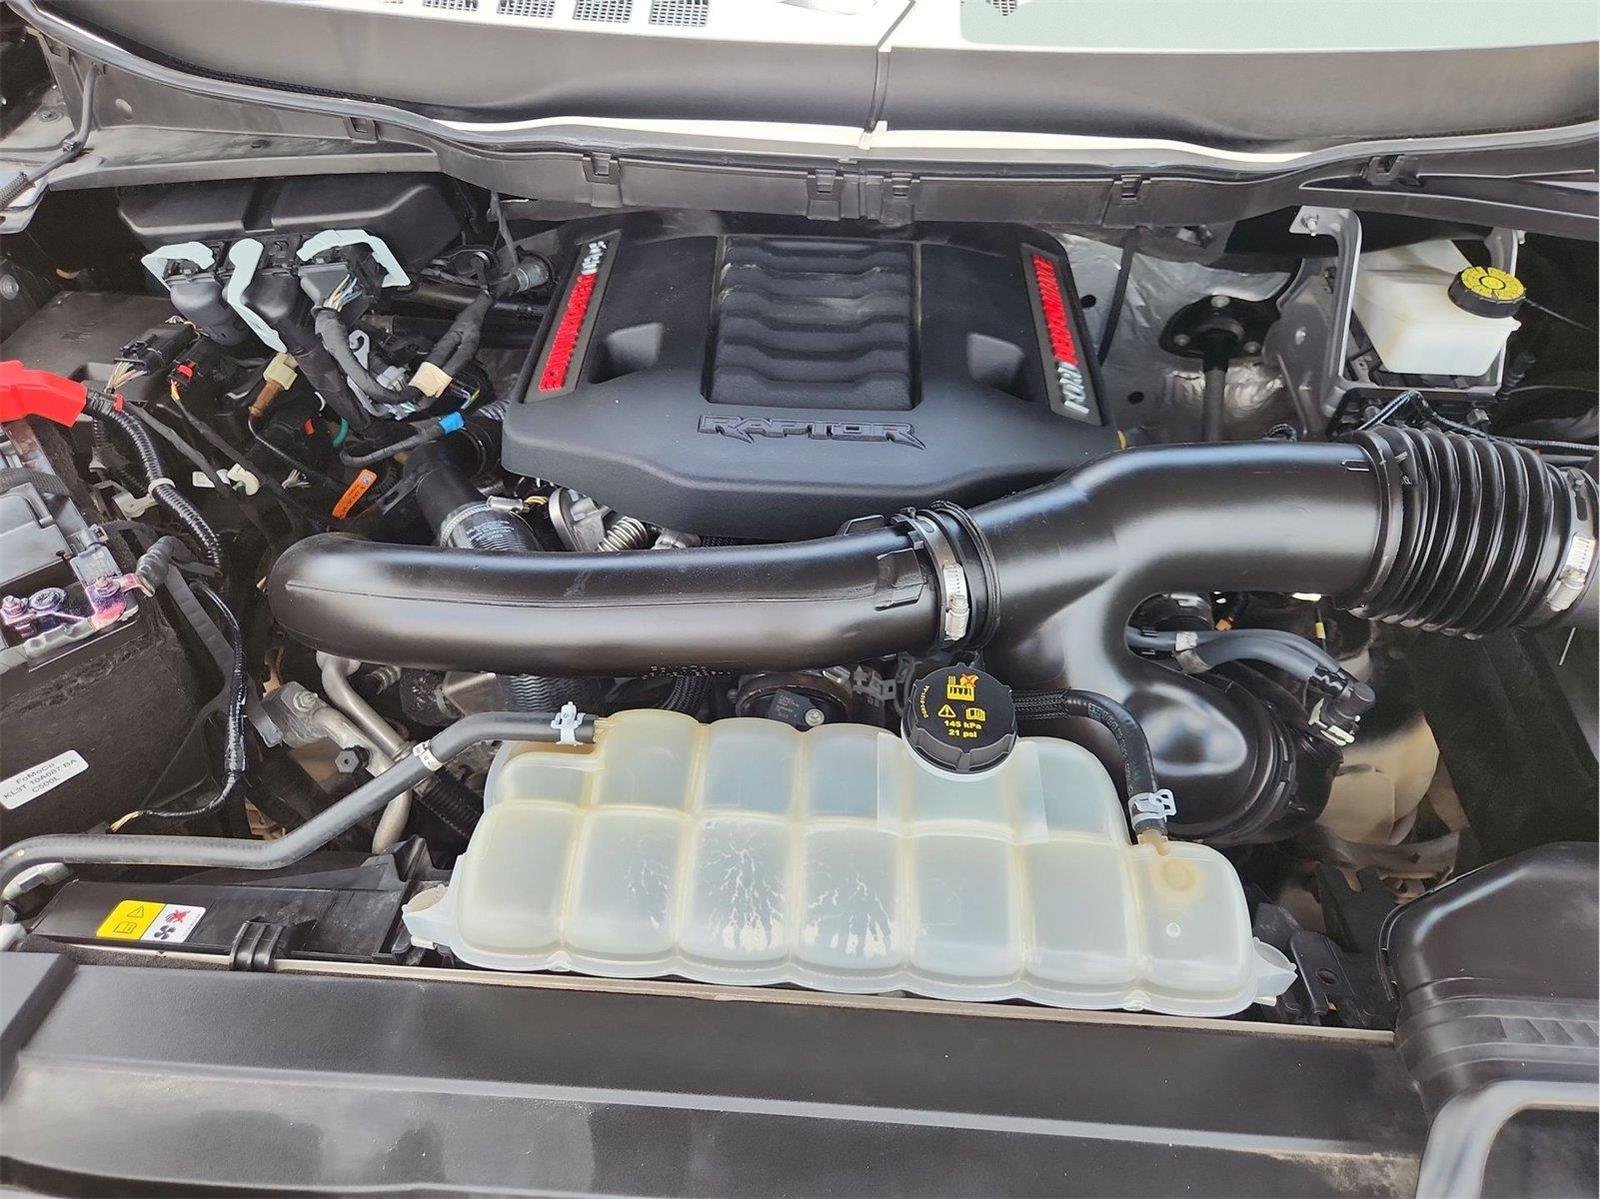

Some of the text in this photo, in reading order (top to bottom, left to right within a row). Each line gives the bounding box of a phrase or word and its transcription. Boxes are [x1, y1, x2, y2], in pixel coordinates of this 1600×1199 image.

[697, 415, 926, 450] RAPTOR
[944, 720, 982, 730] 145 kPa
[948, 728, 960, 736] 21
